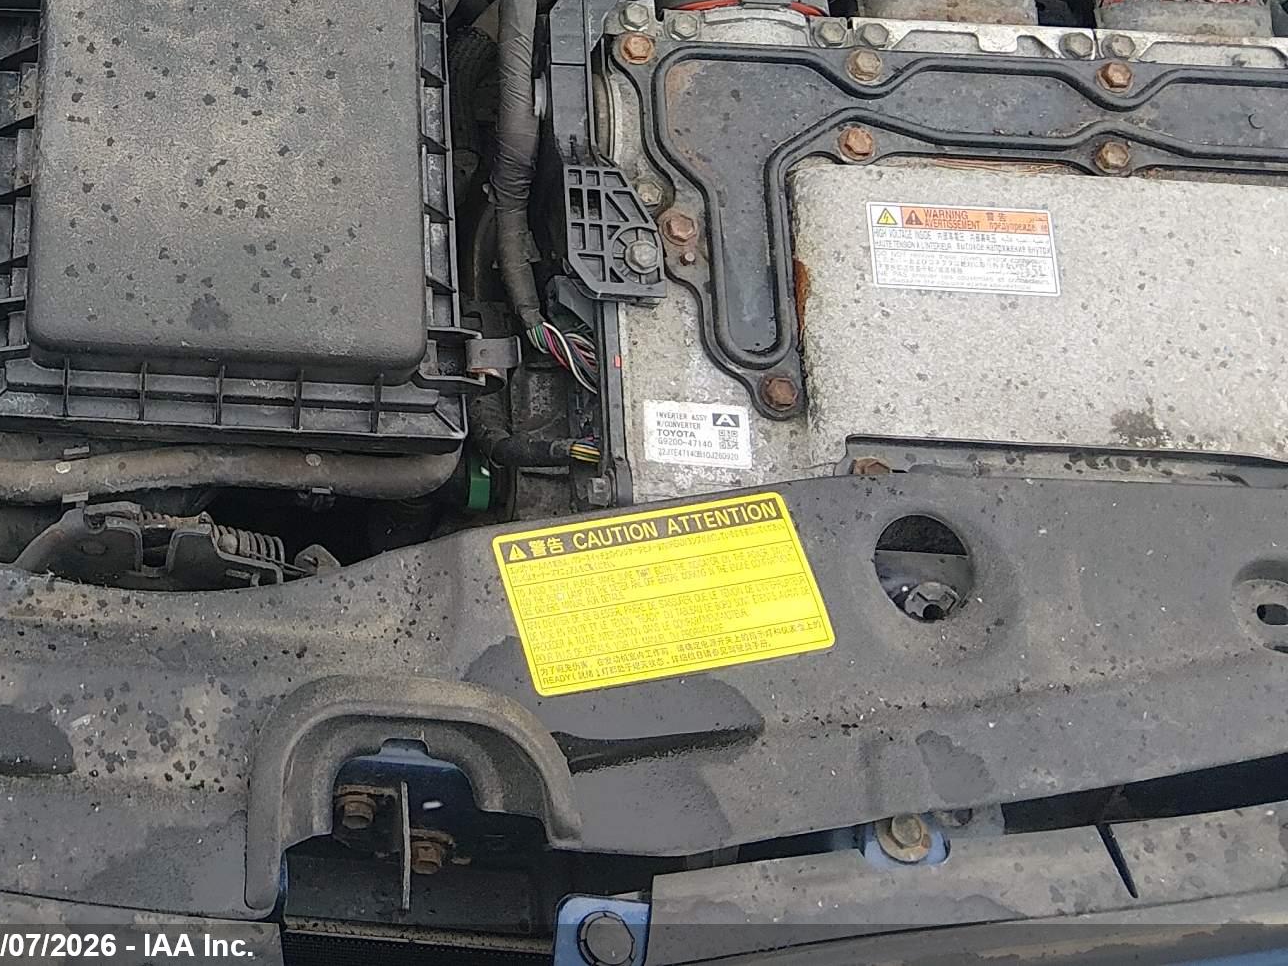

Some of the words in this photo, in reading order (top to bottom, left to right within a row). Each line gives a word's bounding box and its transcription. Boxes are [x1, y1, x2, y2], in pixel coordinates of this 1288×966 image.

[924, 209, 968, 219] WARNING
[925, 218, 981, 229] AVERTISSEMENT
[657, 429, 696, 438] TOYOTA
[570, 519, 659, 551] CAUTION
[663, 499, 777, 535] ATTENTION
[527, 535, 566, 557] 警告
